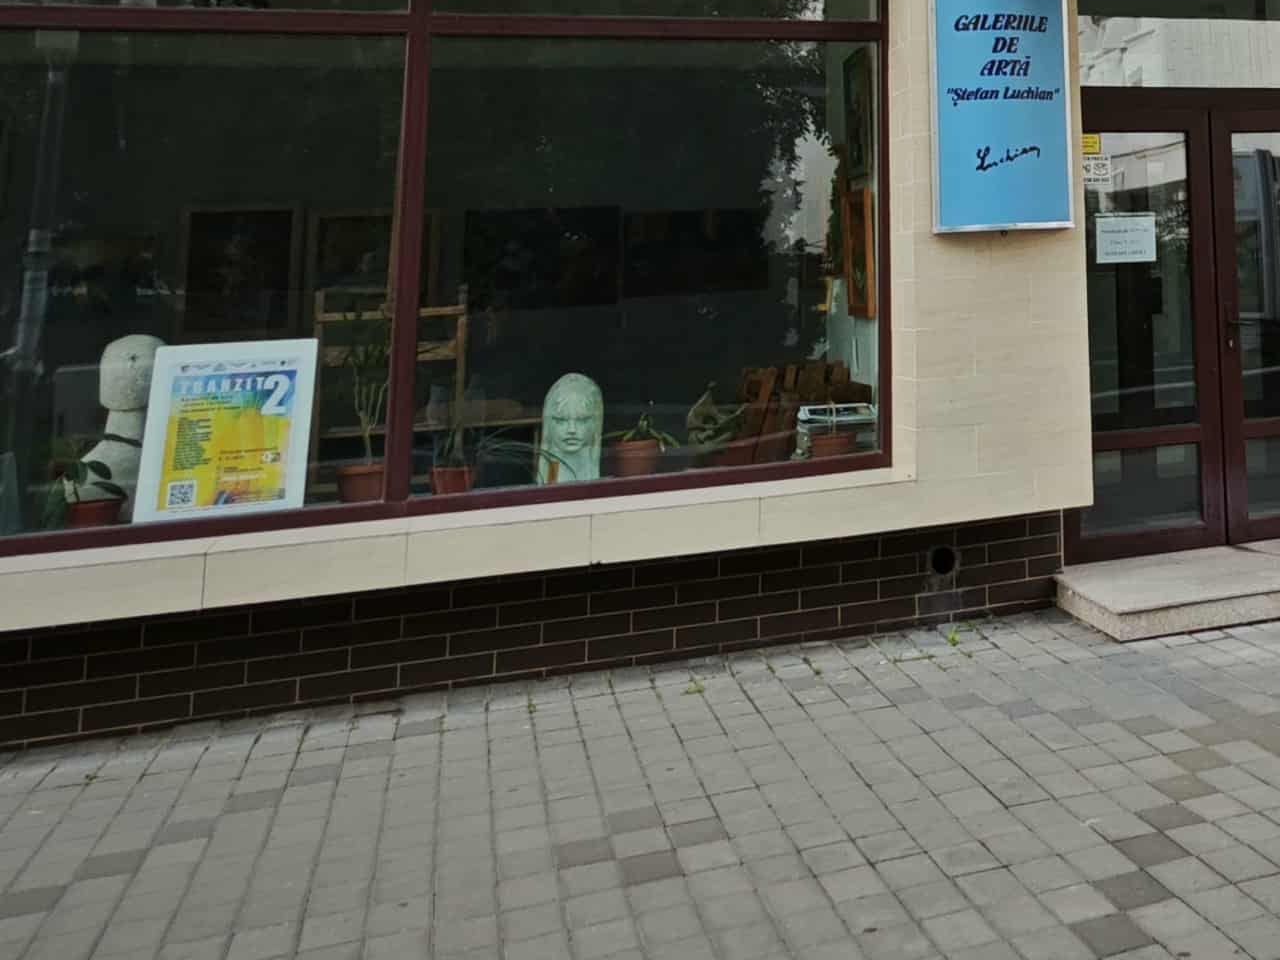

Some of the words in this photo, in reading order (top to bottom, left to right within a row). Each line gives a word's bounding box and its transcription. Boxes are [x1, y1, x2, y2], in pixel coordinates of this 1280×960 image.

[954, 14, 1048, 32] GALERIILE
[992, 37, 1019, 53] DE
[261, 374, 290, 415] 2
